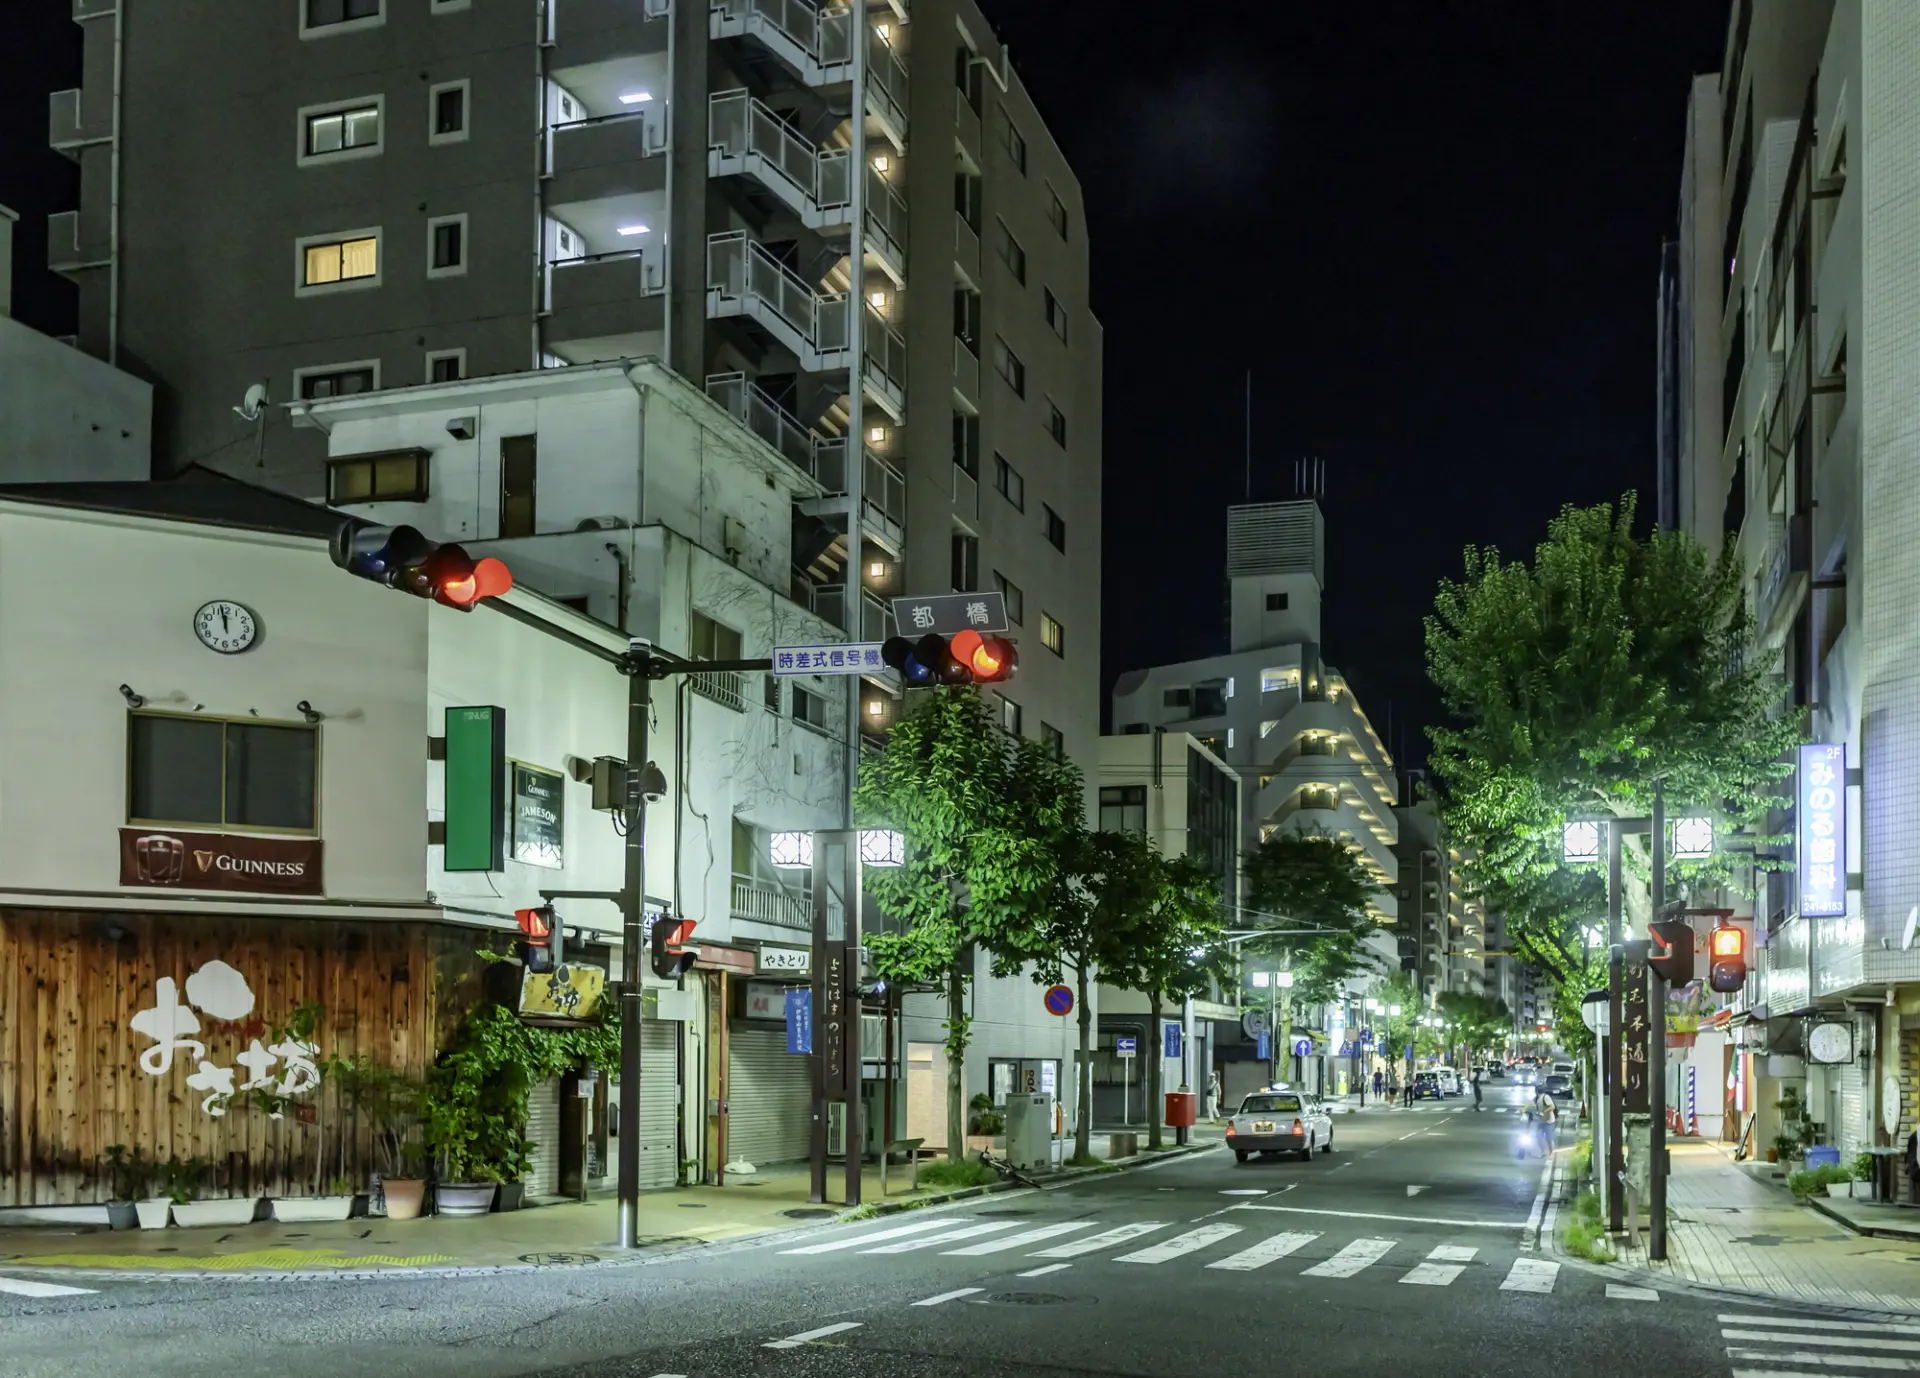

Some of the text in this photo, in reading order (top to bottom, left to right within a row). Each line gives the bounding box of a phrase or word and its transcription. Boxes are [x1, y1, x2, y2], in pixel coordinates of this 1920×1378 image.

[203, 613, 213, 621] 10
[912, 601, 989, 629] 都橋
[201, 621, 208, 630] 9
[205, 630, 211, 638] 8
[222, 640, 229, 648] 6
[232, 639, 239, 647] 5
[778, 649, 881, 669] 時差式信号機
[1826, 747, 1841, 760] 2F
[520, 806, 557, 824] JAMESON
[1810, 762, 1836, 890] みのる歯科
[215, 854, 305, 876] GUINNESS
[765, 954, 806, 967] やきとり
